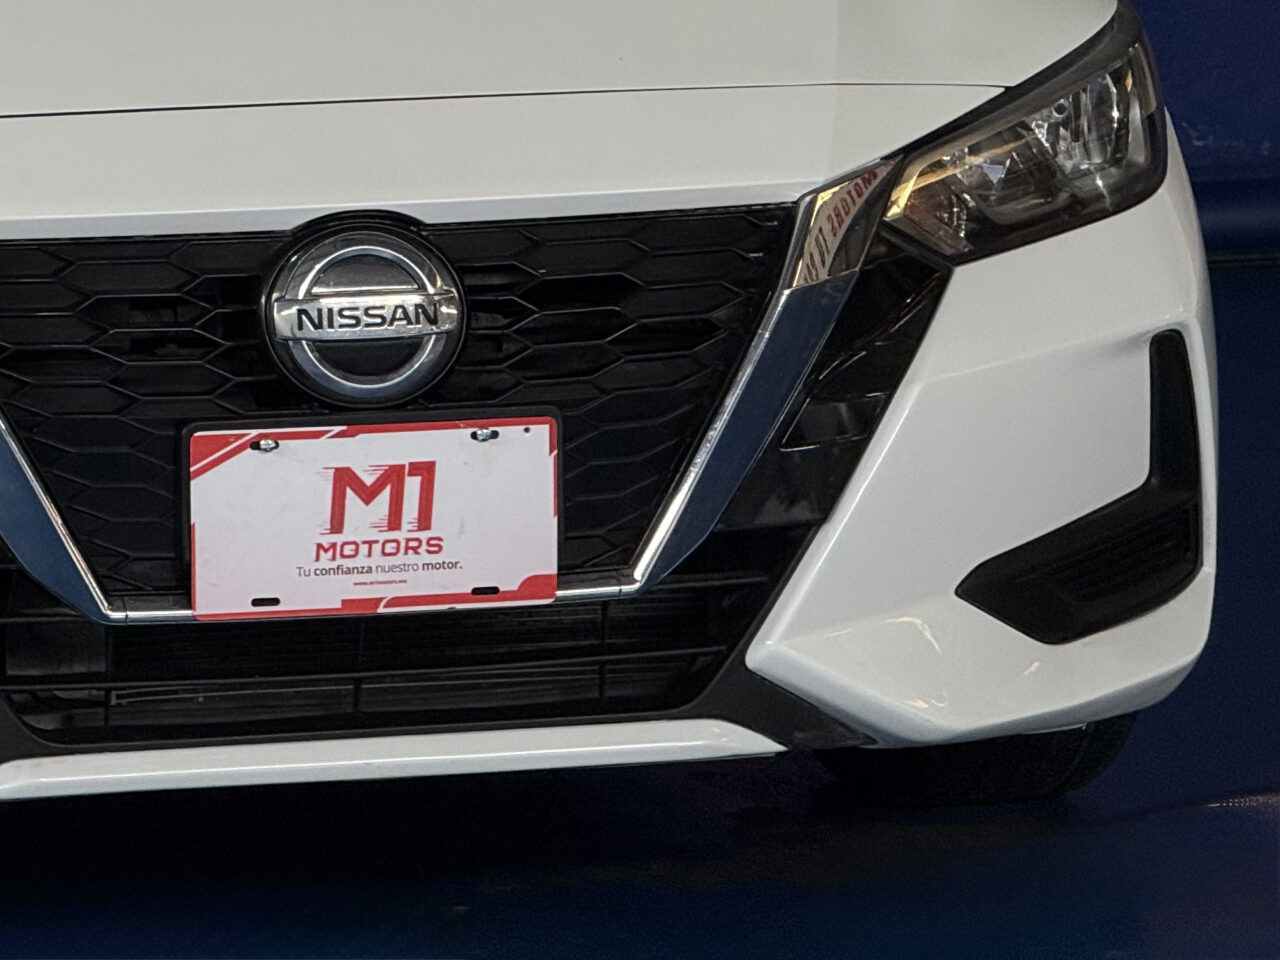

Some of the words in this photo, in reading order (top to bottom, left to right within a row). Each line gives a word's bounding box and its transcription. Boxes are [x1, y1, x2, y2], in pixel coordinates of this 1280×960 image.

[296, 302, 439, 332] NISSAN
[319, 460, 437, 536] M1
[313, 536, 445, 563] MOTORS
[296, 566, 311, 578] Tu
[313, 564, 373, 577] confianza
[375, 562, 419, 574] nuestro
[421, 560, 463, 572] motor.
